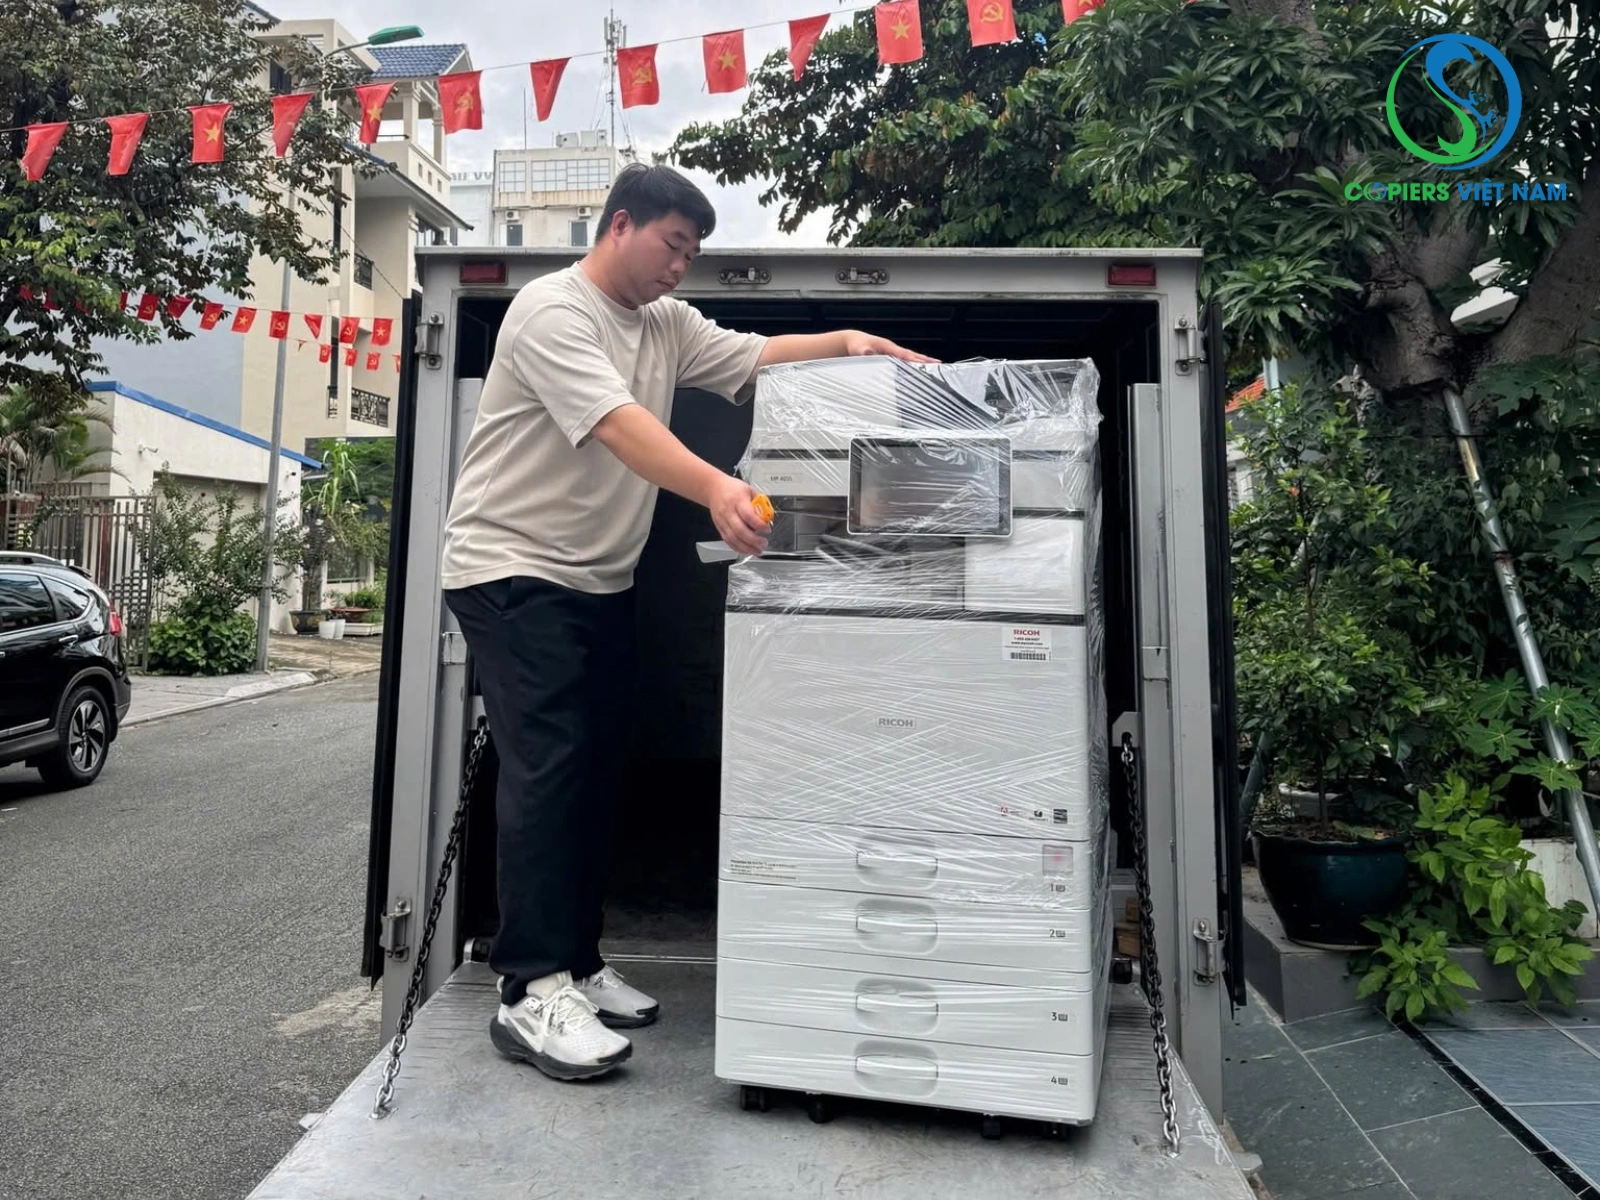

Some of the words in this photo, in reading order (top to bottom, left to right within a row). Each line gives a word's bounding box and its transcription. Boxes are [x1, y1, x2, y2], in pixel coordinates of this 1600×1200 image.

[878, 717, 914, 727] RICOH
[1049, 928, 1055, 938] 2
[1051, 1011, 1057, 1021] 3
[1050, 1075, 1057, 1085] 4
